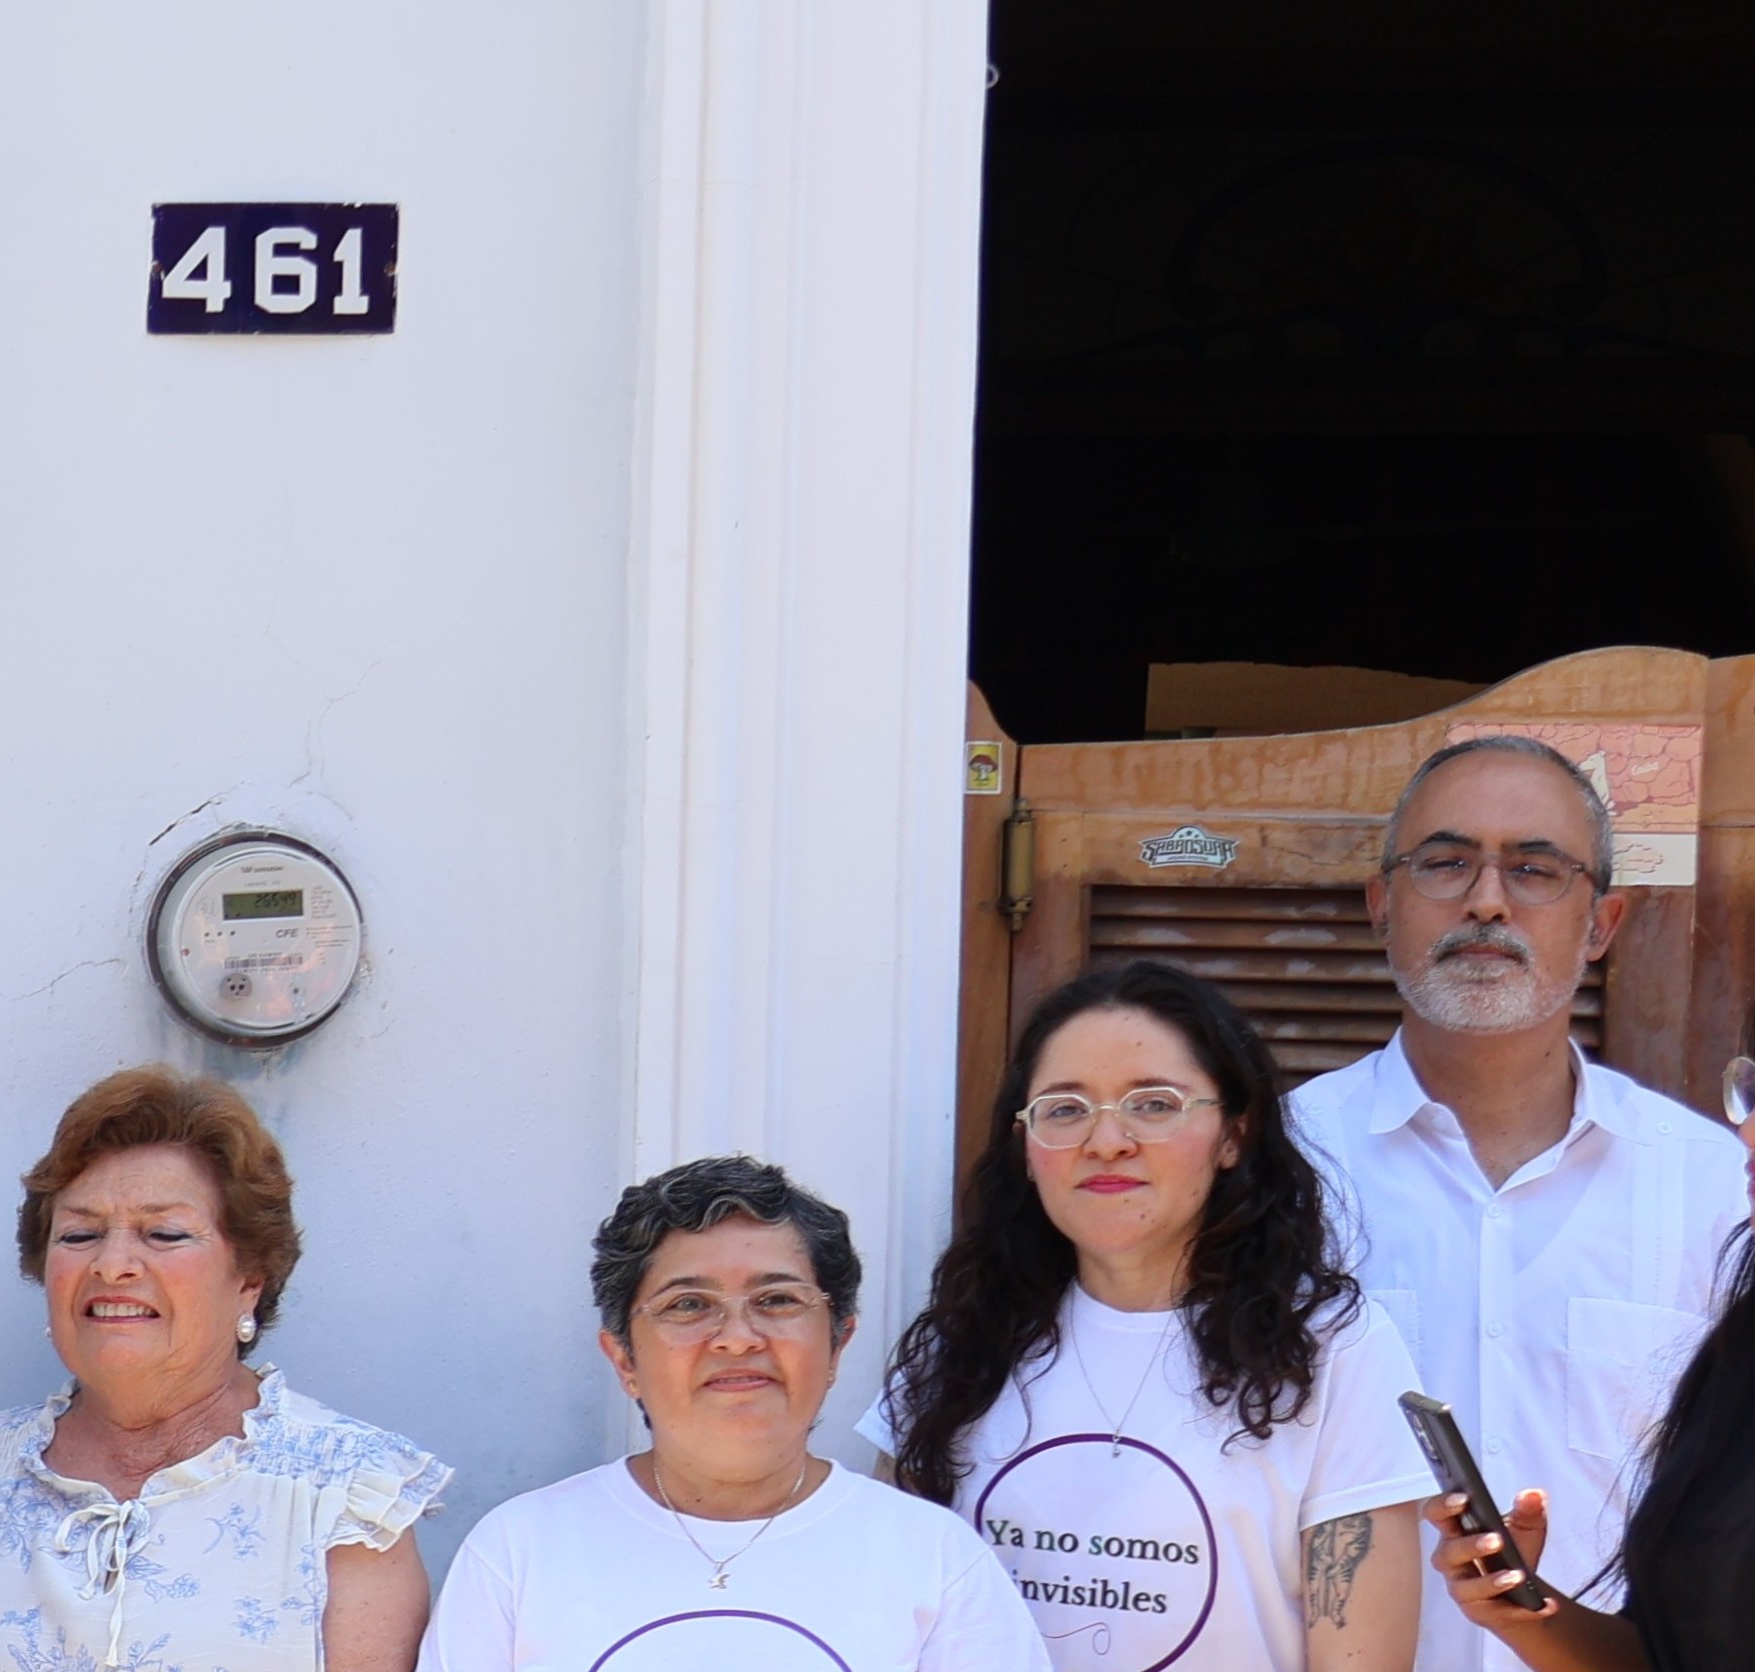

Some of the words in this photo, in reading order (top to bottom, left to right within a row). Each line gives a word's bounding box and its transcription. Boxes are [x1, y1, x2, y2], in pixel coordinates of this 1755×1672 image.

[161, 226, 369, 315] 461
[986, 1519, 1025, 1548] Ya
[1034, 1529, 1079, 1554] no
[1088, 1534, 1200, 1565] somos
